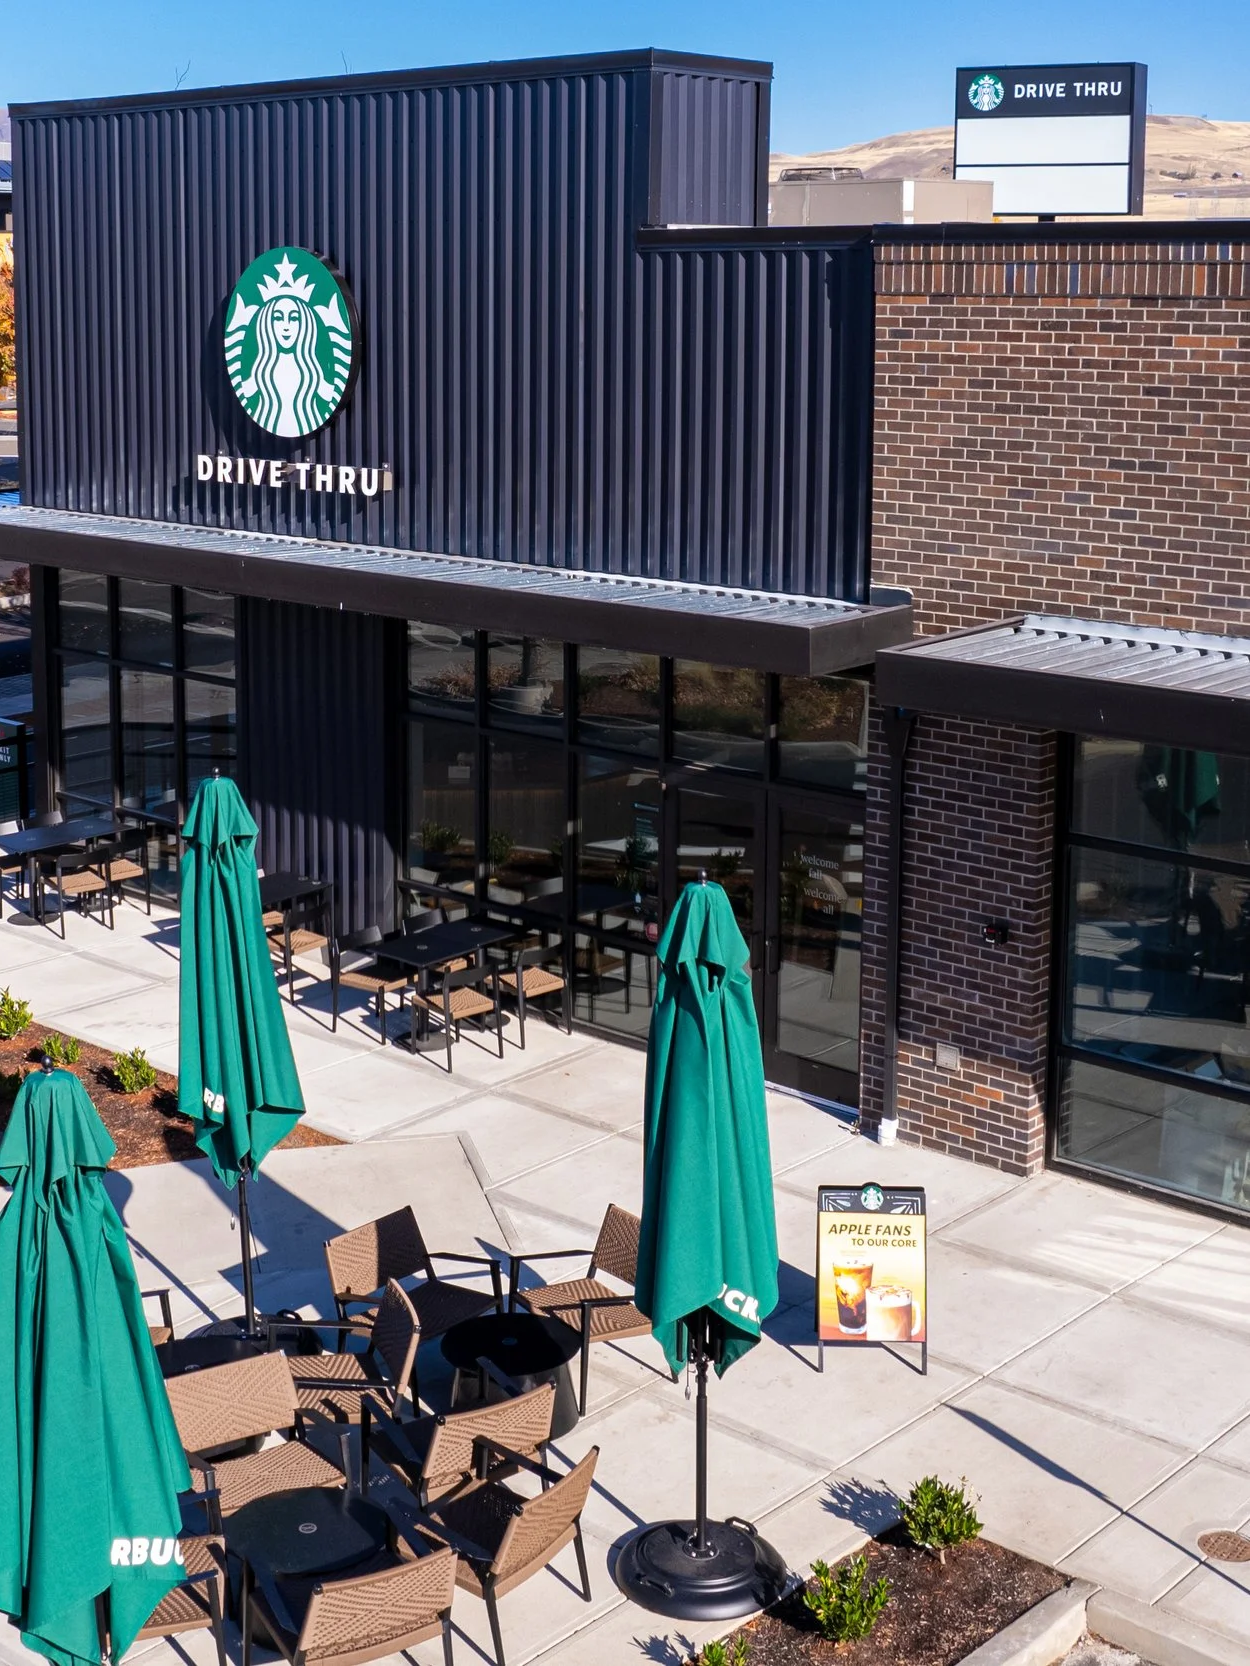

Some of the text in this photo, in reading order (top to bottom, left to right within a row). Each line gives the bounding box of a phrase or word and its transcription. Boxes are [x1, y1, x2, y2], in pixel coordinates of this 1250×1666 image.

[1014, 81, 1122, 98] DRIVE THRU
[197, 454, 379, 497] DRIVE THRU
[800, 854, 840, 870] welcome
[808, 867, 823, 880] fall
[803, 887, 842, 903] welcome
[823, 904, 834, 915] all
[828, 1223, 912, 1236] APPLE FANS
[851, 1238, 917, 1248] TO OUR CORE
